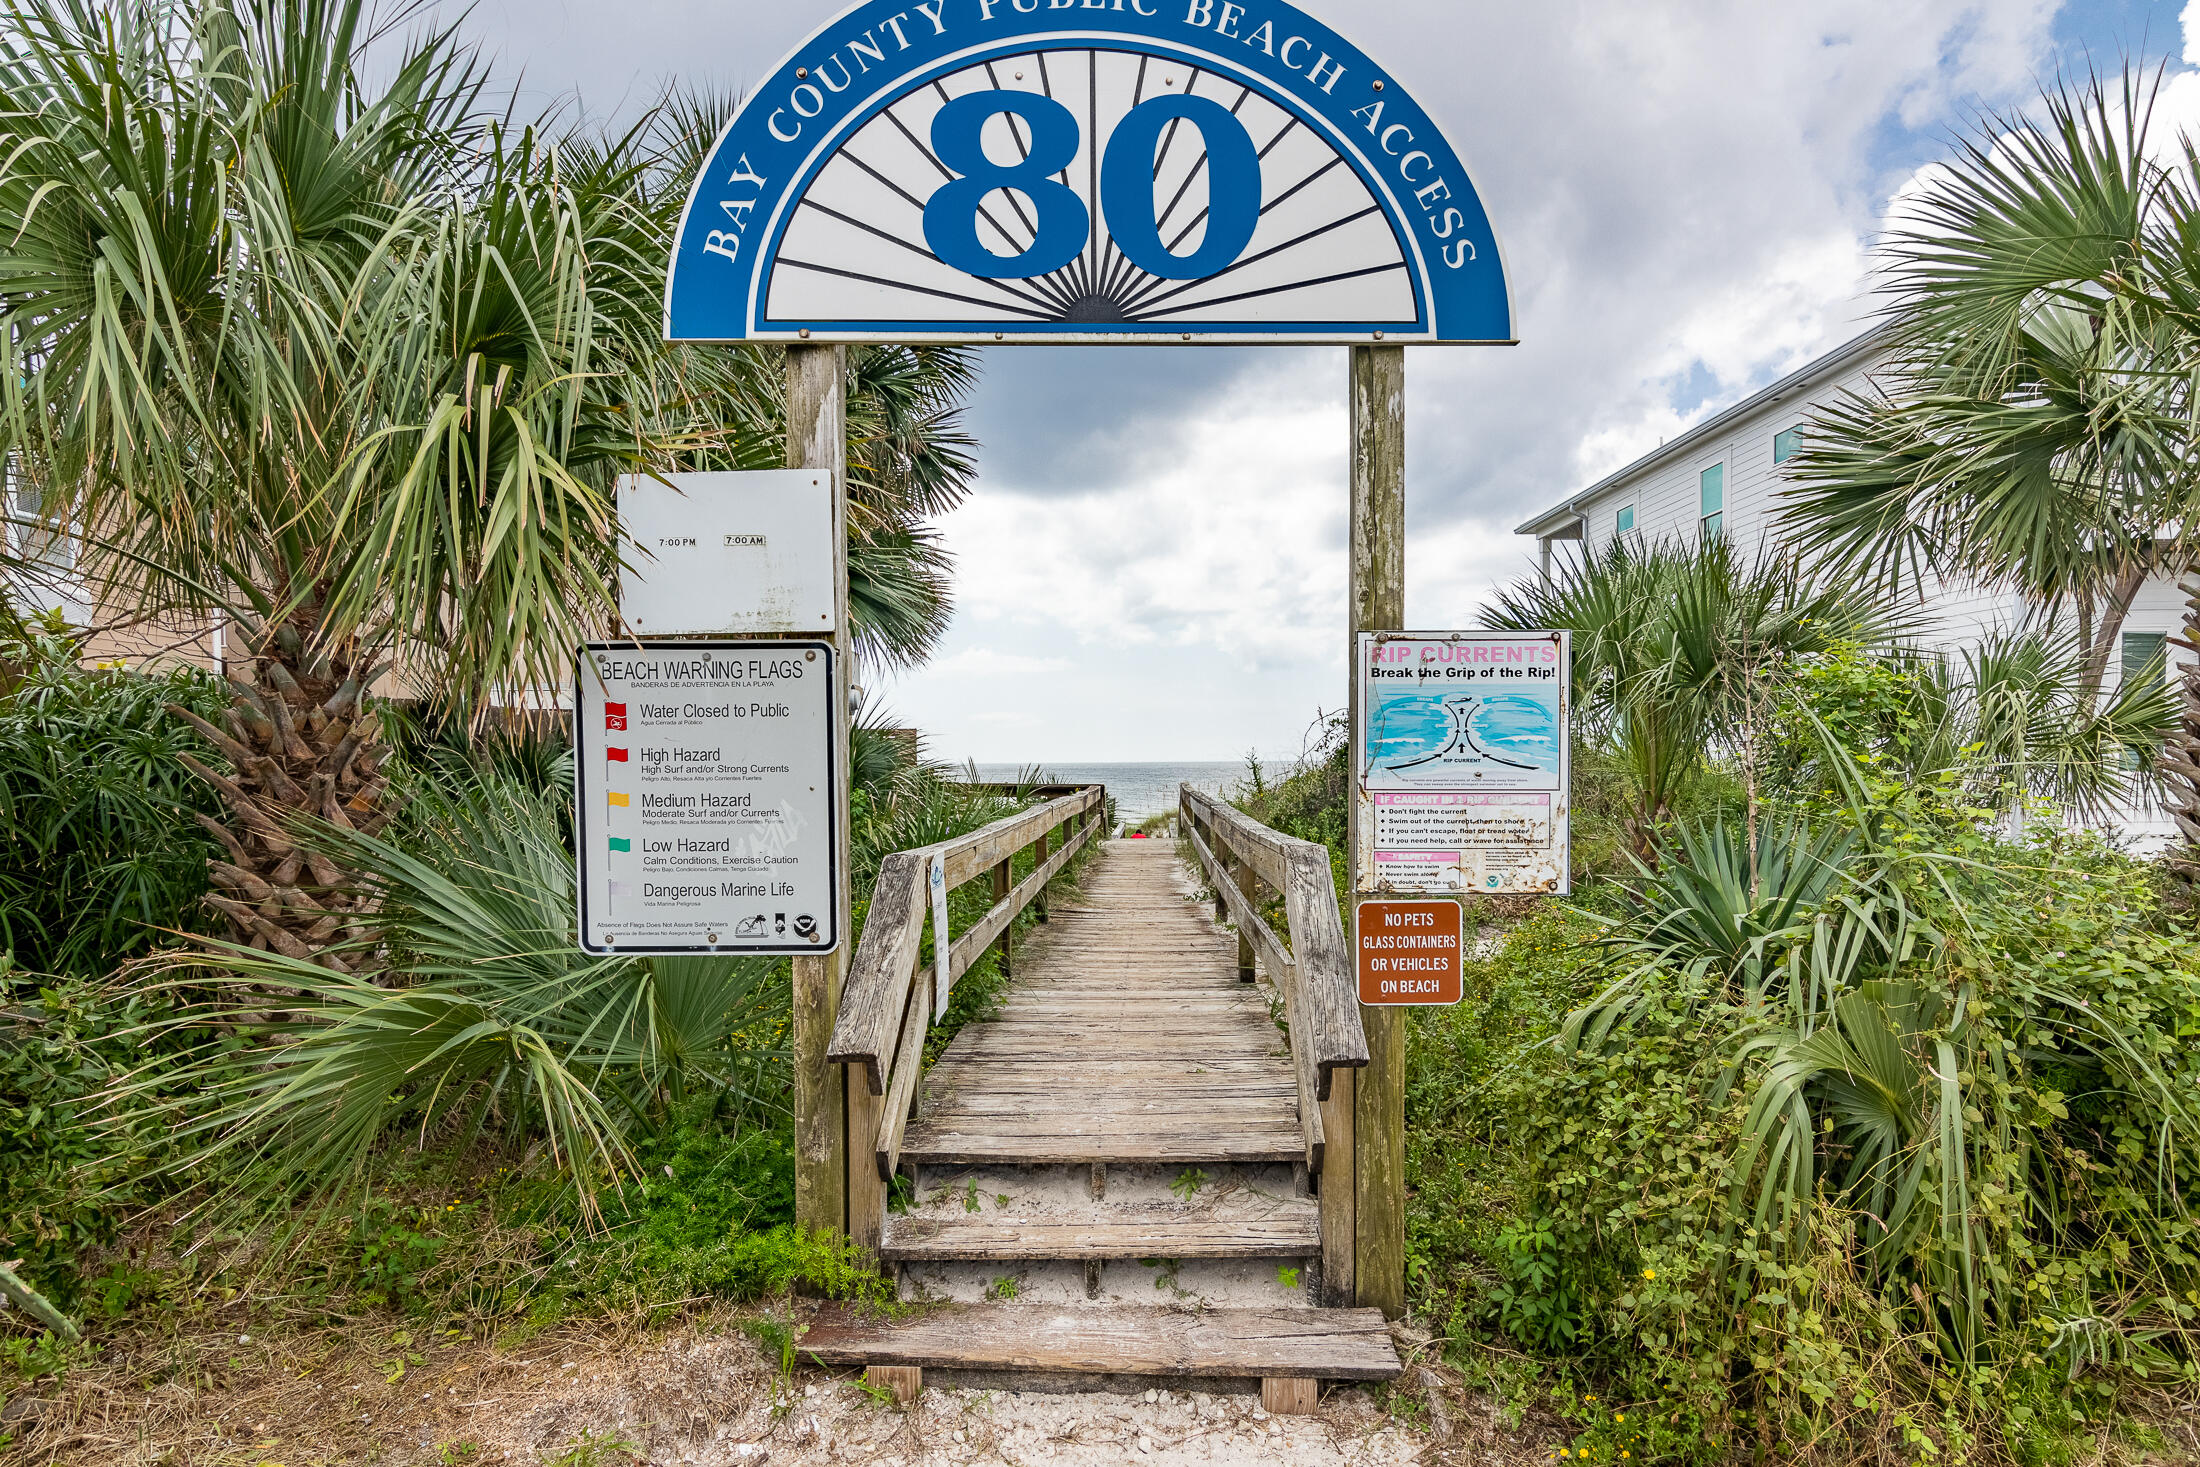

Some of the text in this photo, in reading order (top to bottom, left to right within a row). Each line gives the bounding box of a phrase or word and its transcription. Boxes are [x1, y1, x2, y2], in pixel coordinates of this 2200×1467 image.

[702, 0, 1478, 270] BAY COUNTY BEACH ACCESS
[922, 88, 1262, 280] 80
[659, 538, 696, 546] 7:00 PM
[726, 536, 764, 544] 7:00 AM
[1371, 646, 1556, 663] RIP CURRENTS
[602, 660, 803, 680] BEACH WARNING FLAGS
[1371, 667, 1555, 680] Break the Grip of the Rip!
[639, 703, 790, 718] Water Closed to Public
[641, 748, 720, 765] High Hazard
[641, 764, 790, 775] High Surf and/or Strong Currents
[642, 793, 751, 807] Medium Hazard
[1380, 795, 1391, 804] IF
[1393, 795, 1439, 804] CAUGHT
[642, 809, 780, 818] Moderate Surf and/or Currents
[643, 838, 730, 852] Low Hazard
[643, 855, 799, 866] Calm Conditions, Exercise Caution
[644, 882, 794, 900] Dangerous Marine Life
[1384, 913, 1434, 926] NO PETS
[1363, 935, 1456, 949] GLASS CONTAINERS
[1371, 957, 1449, 971] OR VEHICLES
[1380, 980, 1440, 993] ON BEACH
